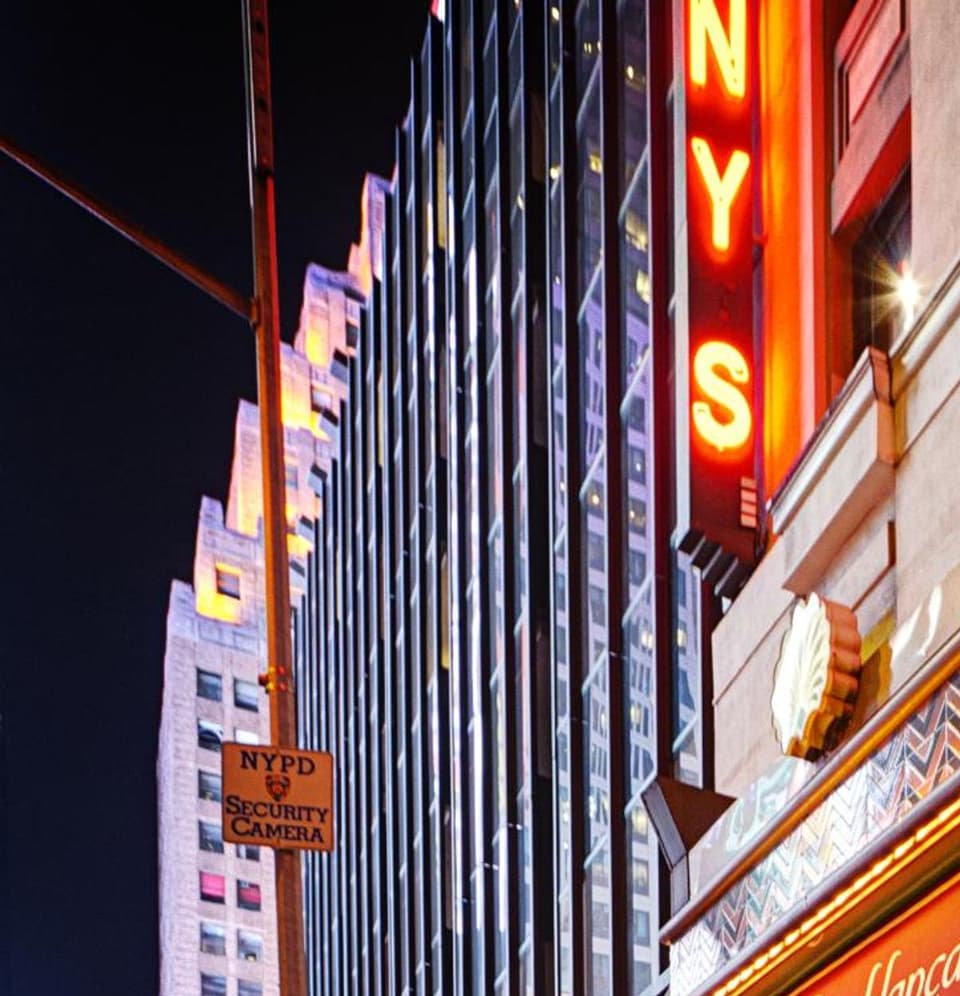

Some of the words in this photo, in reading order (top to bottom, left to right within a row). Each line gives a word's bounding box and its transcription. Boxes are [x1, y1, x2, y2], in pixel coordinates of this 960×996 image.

[240, 750, 316, 776] NYPD
[226, 794, 329, 824] SECURITY
[231, 816, 325, 843] CAMERA
